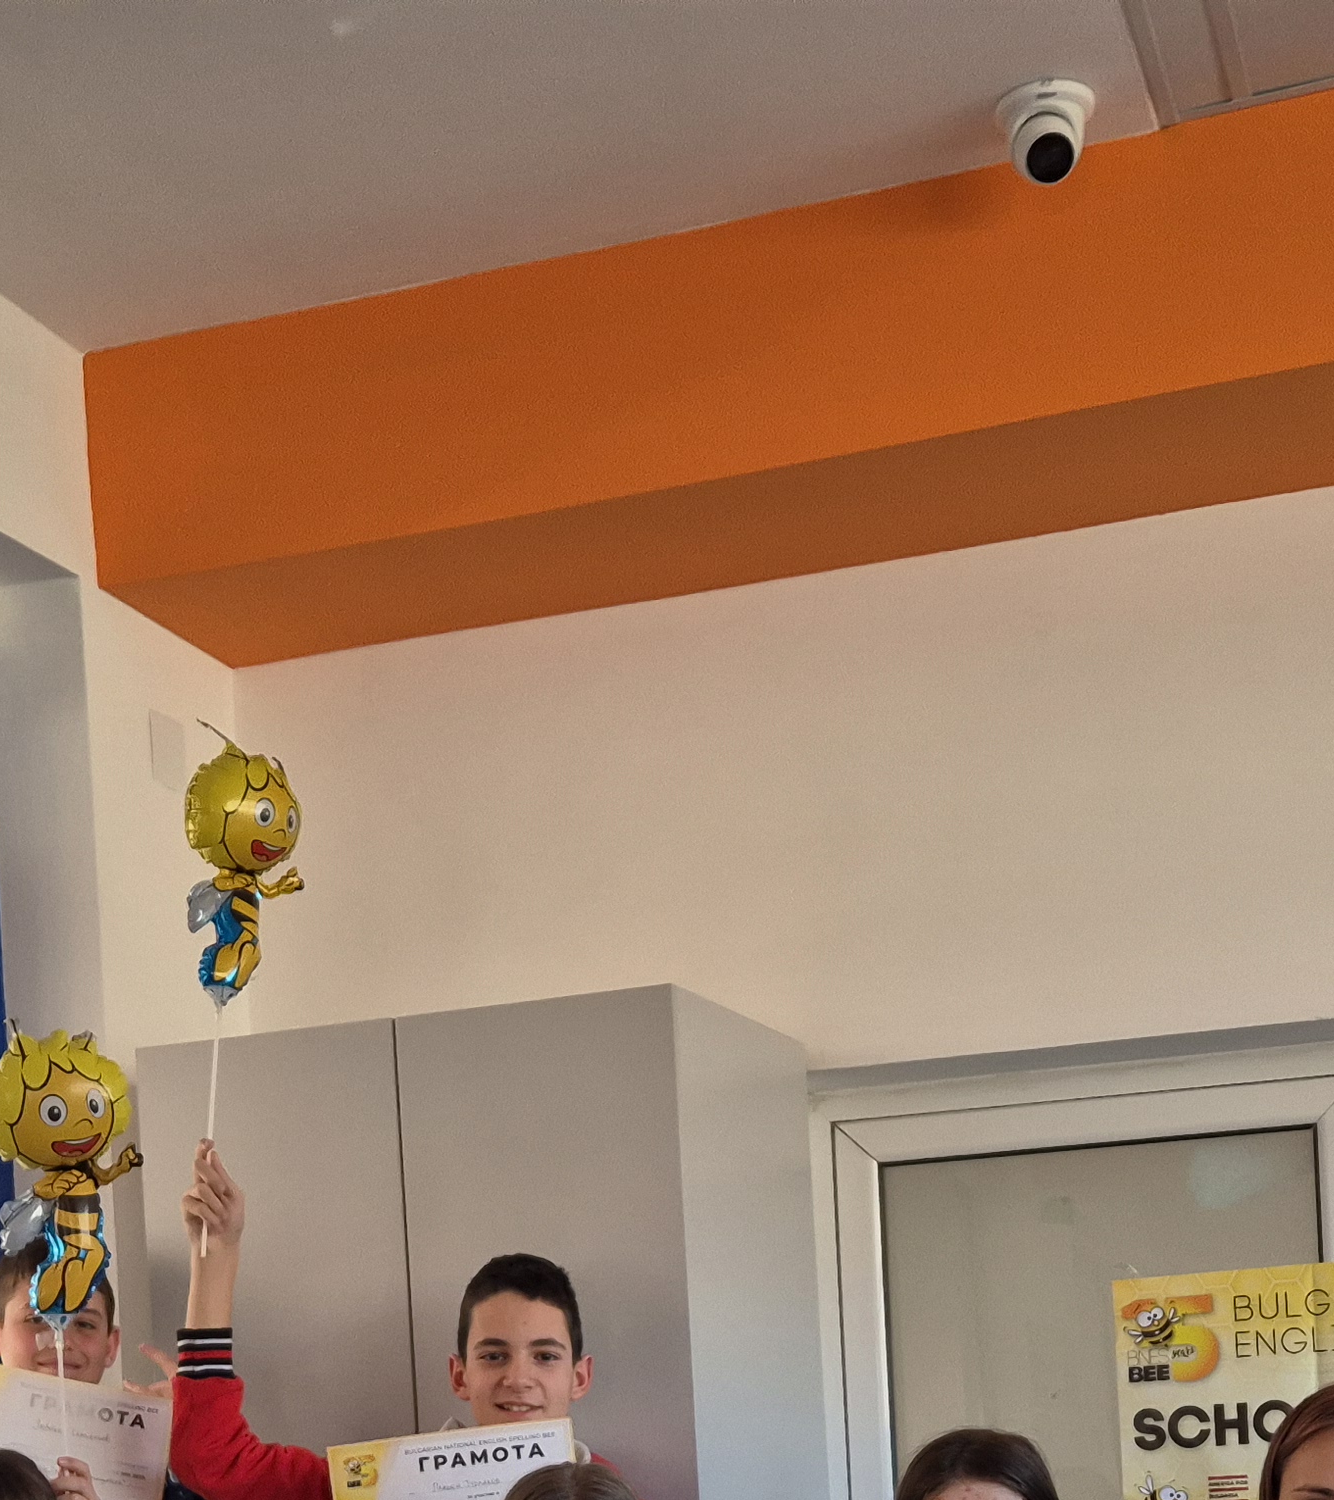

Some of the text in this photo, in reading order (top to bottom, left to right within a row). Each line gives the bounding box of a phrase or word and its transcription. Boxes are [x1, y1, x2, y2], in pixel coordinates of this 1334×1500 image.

[1129, 1364, 1170, 1382] BEE
[1133, 1399, 1295, 1451] SCHO
[418, 1443, 545, 1472] ГРАМОТА
